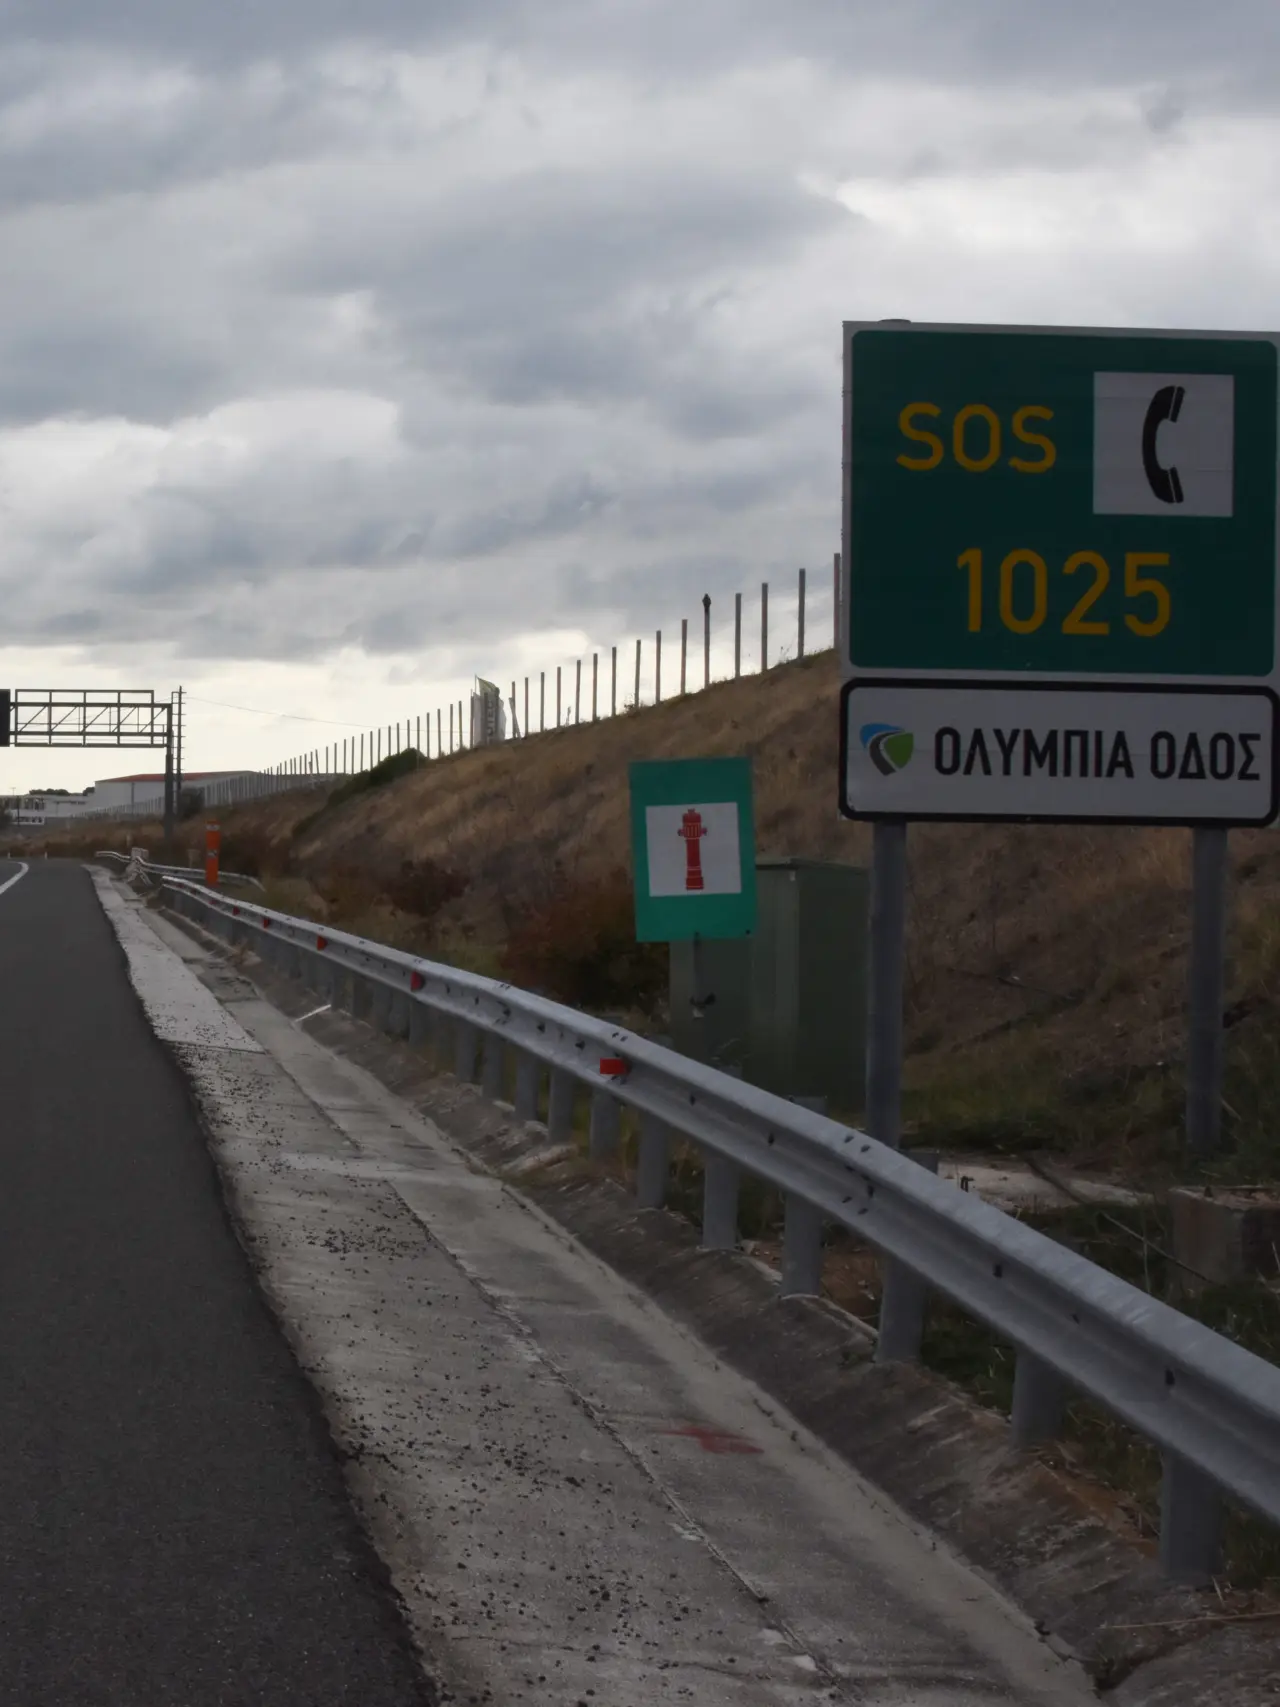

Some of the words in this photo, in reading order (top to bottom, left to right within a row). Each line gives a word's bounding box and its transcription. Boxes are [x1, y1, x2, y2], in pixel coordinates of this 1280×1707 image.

[895, 402, 1057, 474] SOS
[956, 547, 1172, 637] 1025
[934, 726, 1135, 779] ΟΛΥΜΠΙΑ
[1149, 730, 1261, 781] ΟΔΟΣ
